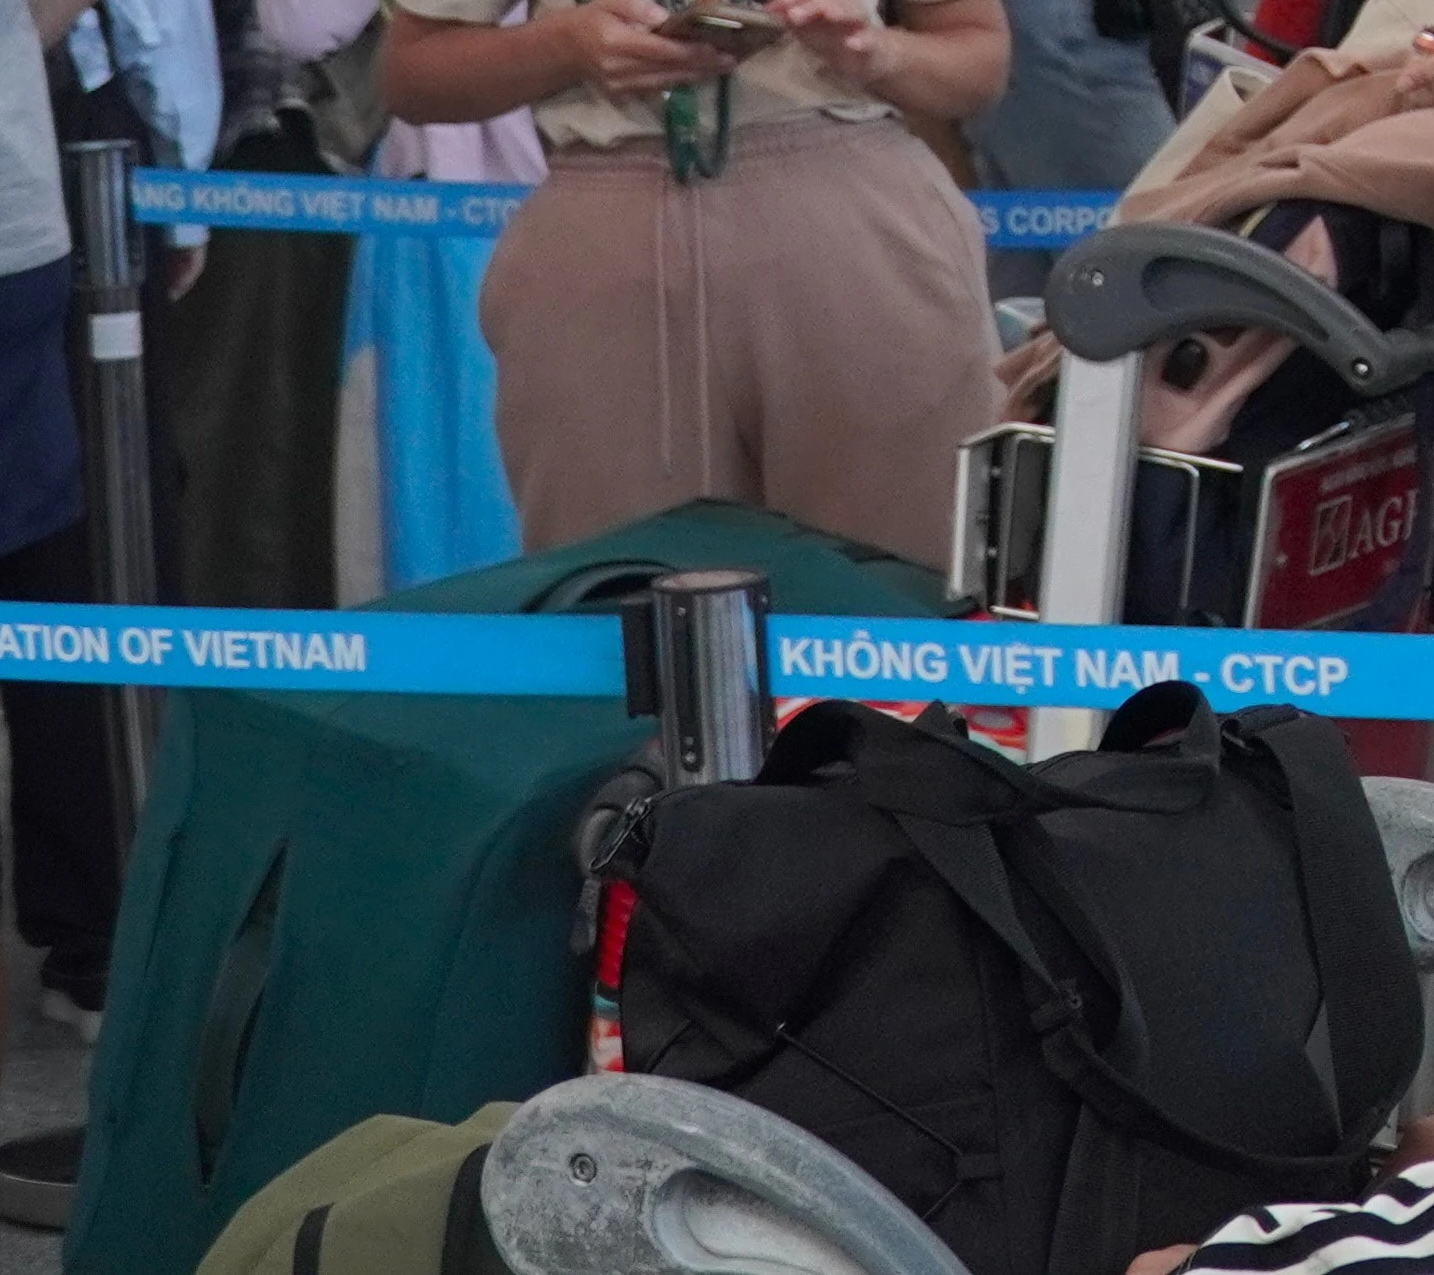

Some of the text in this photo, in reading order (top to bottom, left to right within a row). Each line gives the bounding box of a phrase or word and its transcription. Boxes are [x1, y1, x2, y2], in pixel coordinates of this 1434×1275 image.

[191, 180, 295, 217] KHÔNG
[302, 189, 366, 224] VIỆT
[373, 195, 439, 225] NAM
[119, 627, 173, 666] OF
[182, 629, 366, 672] VIETNAM
[779, 630, 947, 684] KHÔNG
[960, 644, 1062, 695] VIỆT
[1076, 650, 1179, 689] NAM
[1220, 655, 1348, 696] CTCP
